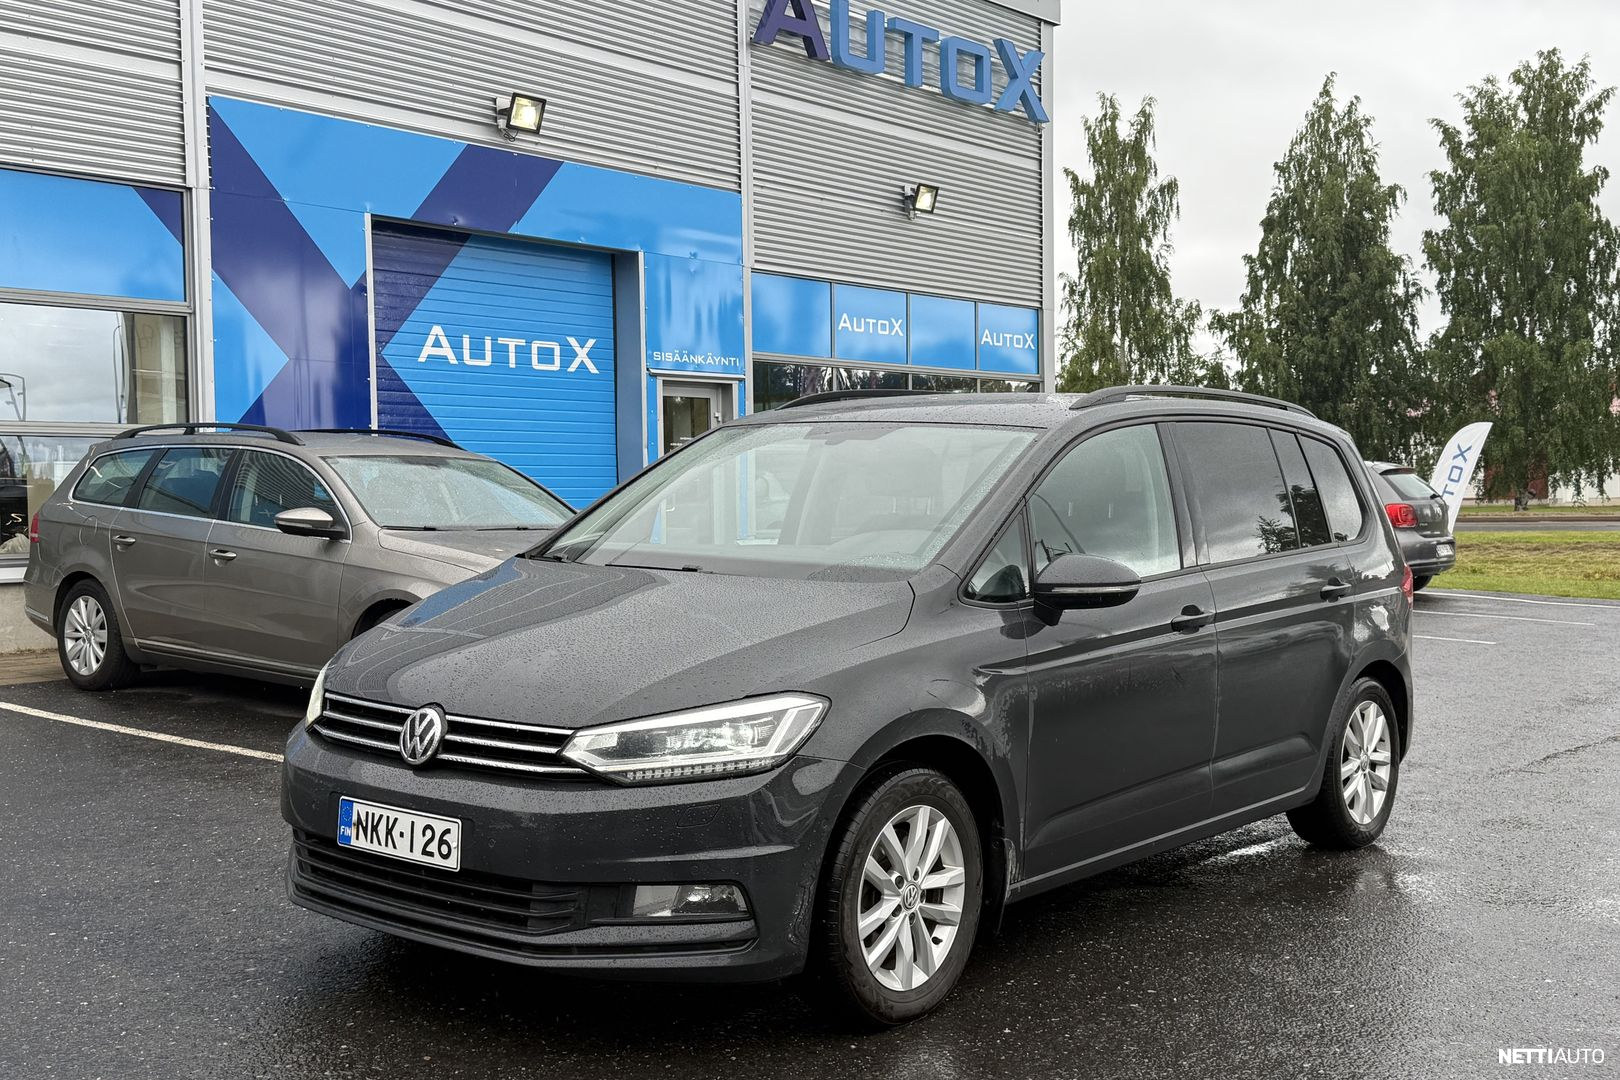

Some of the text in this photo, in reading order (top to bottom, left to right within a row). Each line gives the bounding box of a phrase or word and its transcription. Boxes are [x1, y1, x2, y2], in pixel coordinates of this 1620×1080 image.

[838, 313, 904, 337] AUTOX
[418, 325, 600, 374] AUTOX
[981, 329, 1035, 350] AUTOX
[653, 350, 739, 366] SISÄÄNKÄYNTI
[1441, 443, 1473, 498] TOX
[340, 825, 352, 836] FIN
[355, 808, 452, 860] NKK-126
